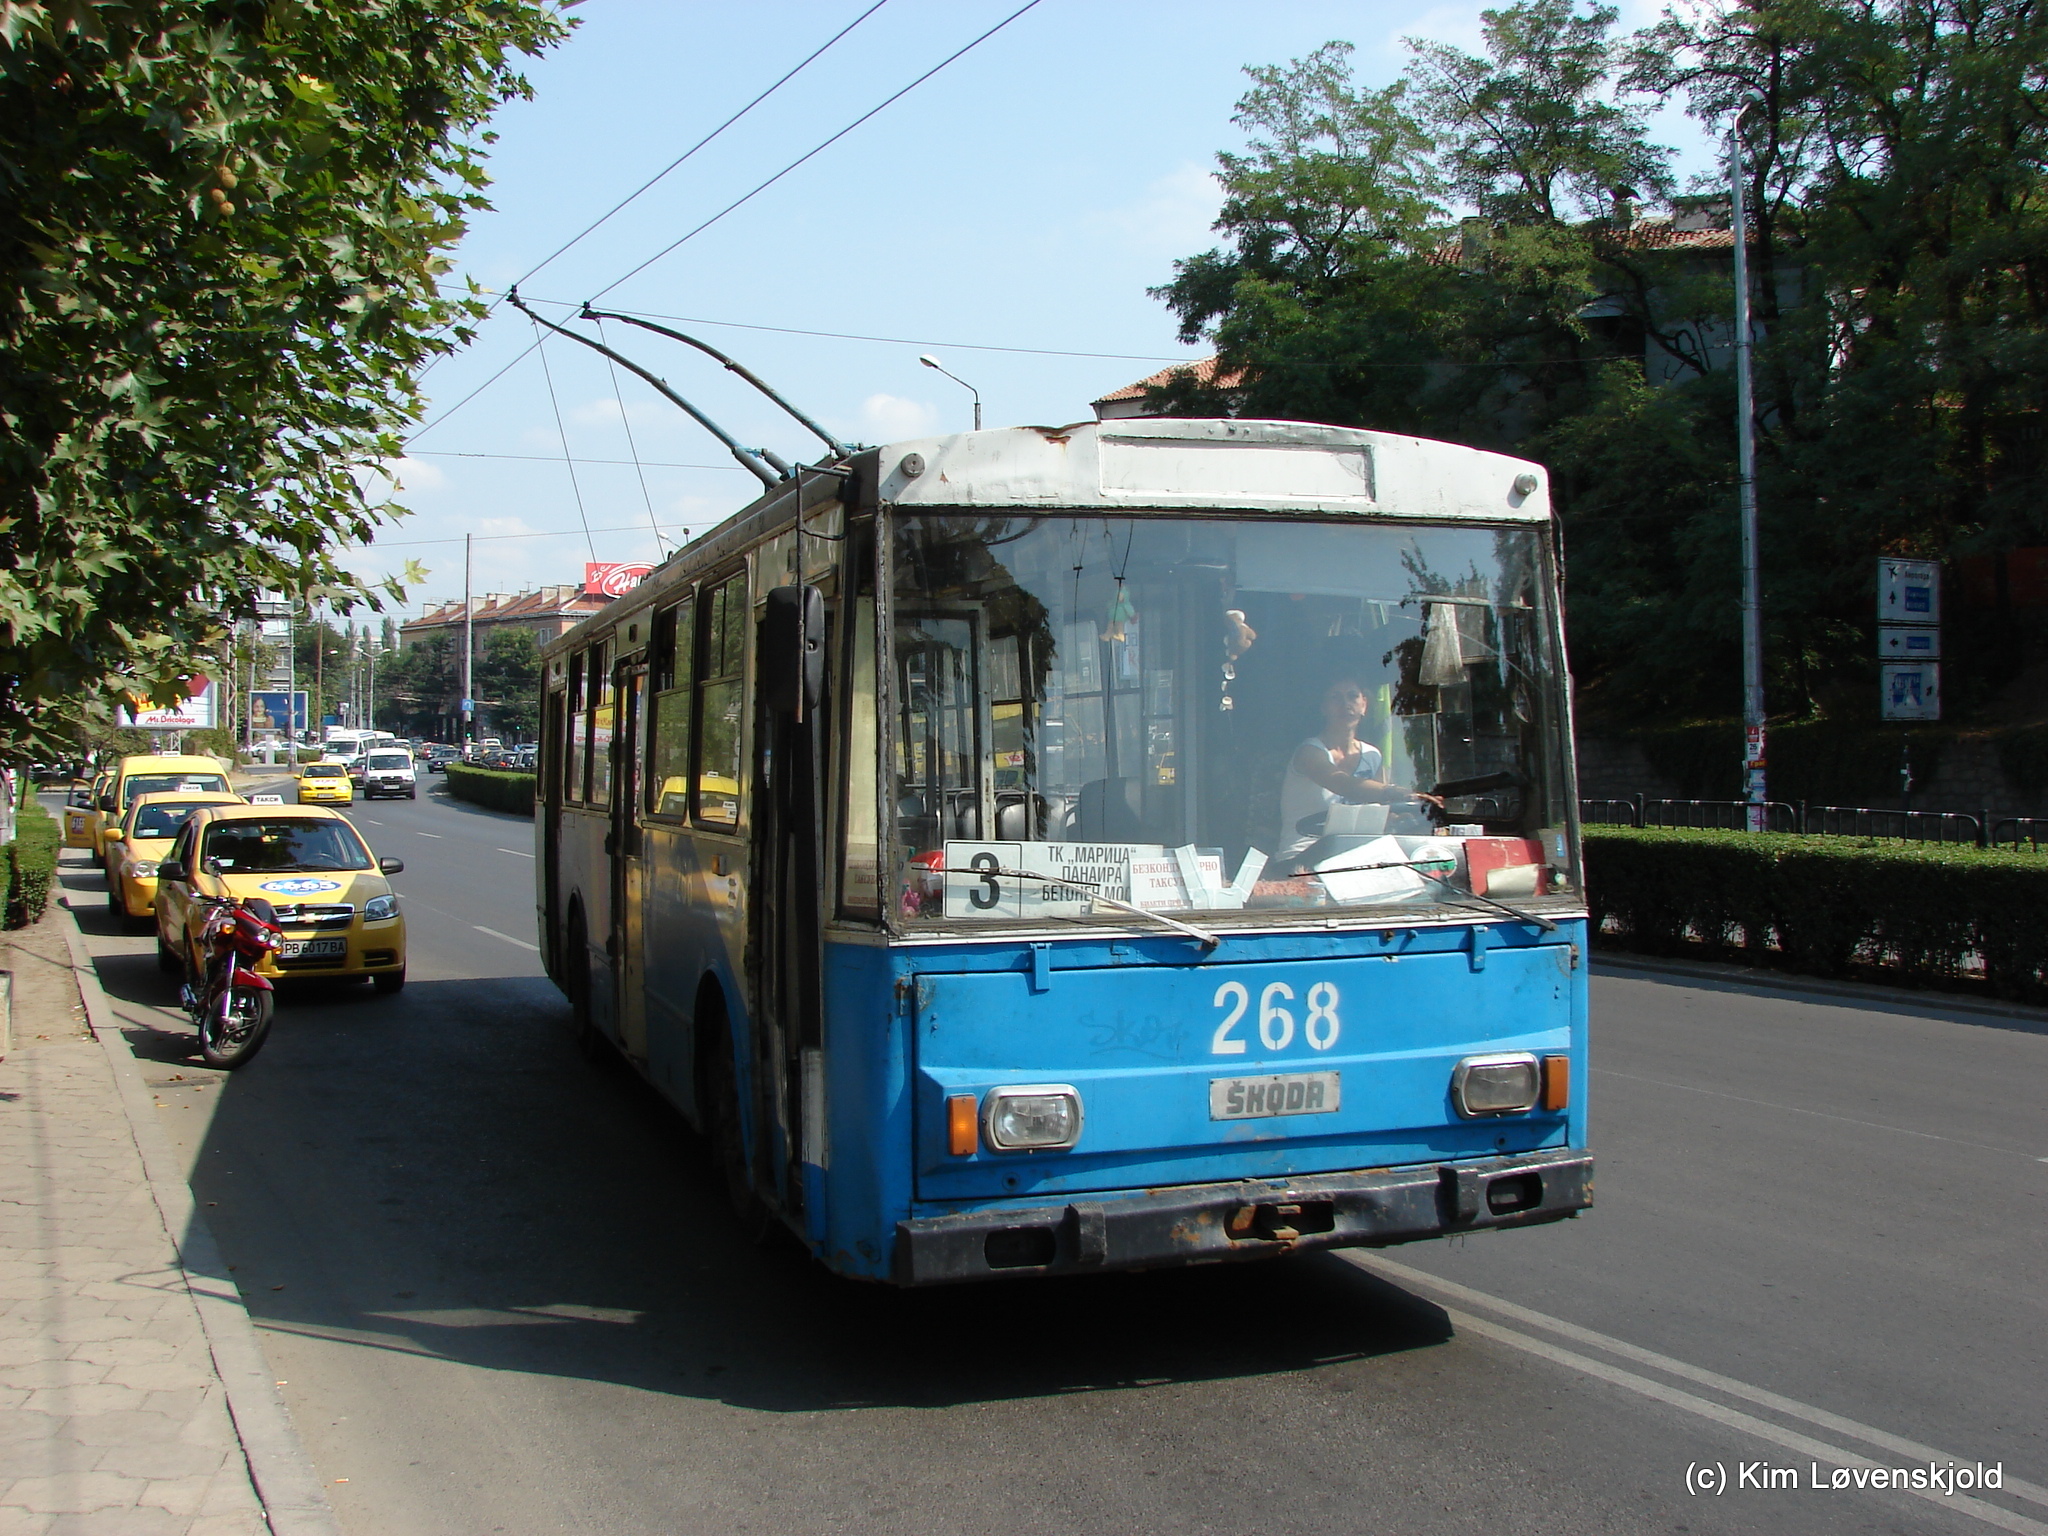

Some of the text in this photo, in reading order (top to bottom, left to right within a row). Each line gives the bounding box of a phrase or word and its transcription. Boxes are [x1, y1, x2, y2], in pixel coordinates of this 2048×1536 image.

[160, 715, 196, 725] Bricolage
[1048, 846, 1063, 863] ТК
[969, 851, 1001, 910] 3
[1062, 866, 1122, 883] ПАНАИРА
[265, 881, 336, 892] 6665
[284, 940, 345, 954] PB 6017 BA
[1210, 980, 1340, 1054] 268
[1225, 1081, 1325, 1115] ŠKODA
